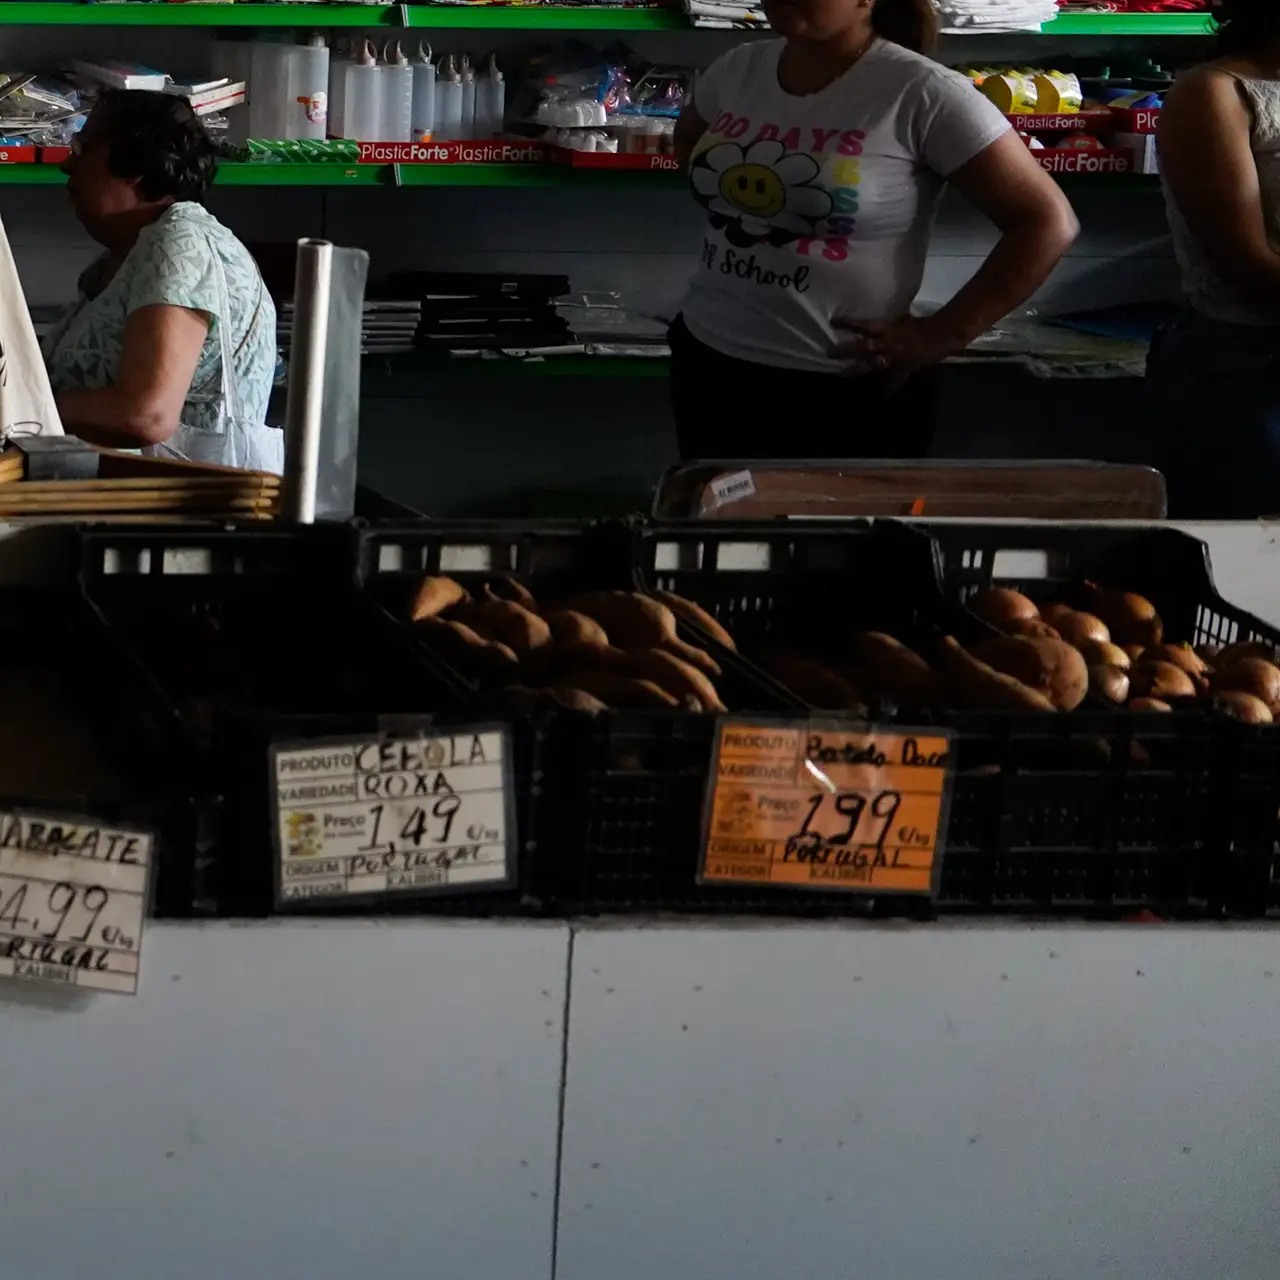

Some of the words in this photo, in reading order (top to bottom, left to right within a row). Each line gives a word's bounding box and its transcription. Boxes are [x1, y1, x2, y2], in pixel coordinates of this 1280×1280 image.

[1015, 115, 1087, 129] PlasticForte
[361, 142, 449, 161] PlasticForte
[650, 156, 681, 170] Plas
[1035, 152, 1129, 172] asticForte
[720, 249, 810, 293] School
[724, 733, 798, 750] PRODUTO
[280, 752, 352, 771] PRODUTO
[365, 772, 455, 797] ROXA
[758, 796, 800, 812] Preço
[324, 814, 366, 829] Preço
